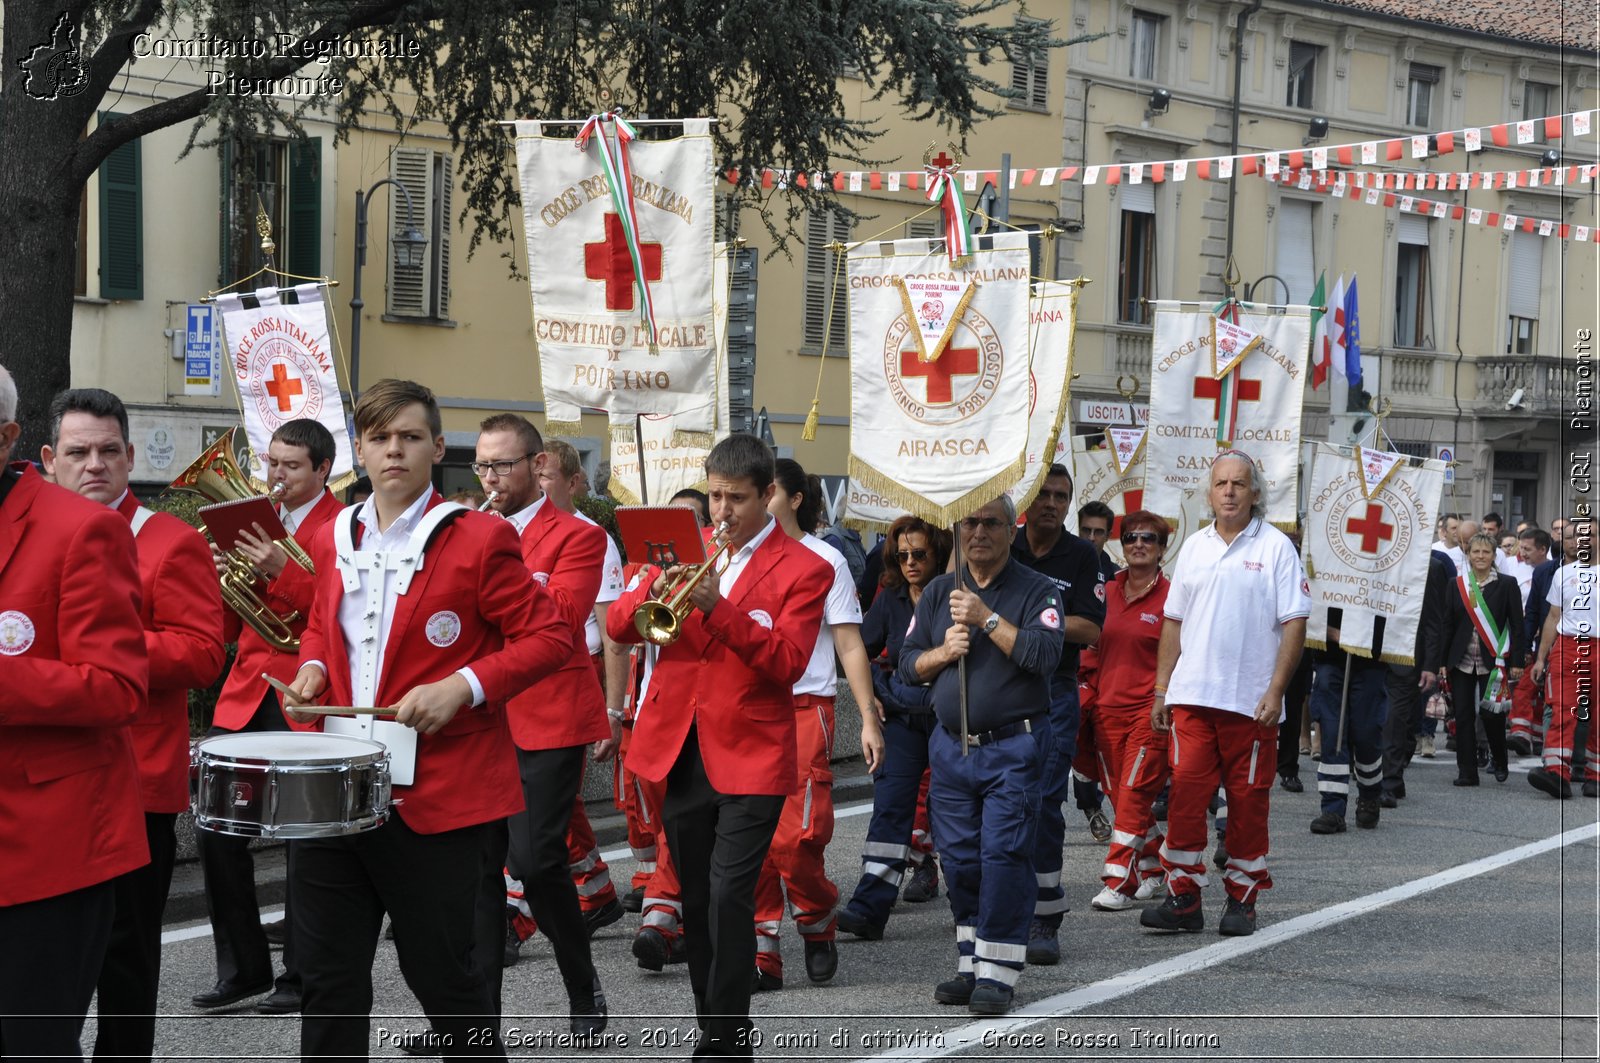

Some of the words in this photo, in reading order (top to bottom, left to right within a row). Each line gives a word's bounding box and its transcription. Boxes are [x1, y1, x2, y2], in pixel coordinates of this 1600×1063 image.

[540, 186, 583, 228] CROCE
[851, 274, 899, 289] CROCE
[963, 267, 1028, 283] ITALIANA
[536, 318, 627, 347] COMITATO
[969, 314, 986, 332] 22
[237, 335, 253, 380] CROCE
[250, 317, 282, 341] ROSSA
[285, 320, 331, 374] ITALIANA
[607, 349, 620, 361] DI
[981, 334, 1000, 390] AGOSTO
[1157, 340, 1196, 373] CROCE
[259, 353, 268, 368] DI
[299, 359, 310, 372] 22
[306, 373, 320, 415] AGOSTO
[573, 364, 670, 391] POIRINO
[885, 333, 925, 418] CONVENZIONE
[958, 392, 986, 417] 1864
[1087, 404, 1125, 421] USCITA
[1156, 425, 1218, 440] COMITAT
[1235, 429, 1291, 441] LOCALE
[898, 438, 990, 458] AIRASCA
[1079, 466, 1107, 507] CROCE
[1313, 475, 1347, 512] CROCE
[1394, 477, 1430, 532] ITALIANA
[1397, 510, 1408, 521] 22
[1329, 502, 1357, 566] CONVENZIONE
[1395, 525, 1410, 558] AGOSTO
[1314, 571, 1369, 587] COMITATO
[1372, 580, 1410, 596] LOCALE
[1358, 587, 1369, 596] DI
[1322, 591, 1397, 614] MONCALIERI
